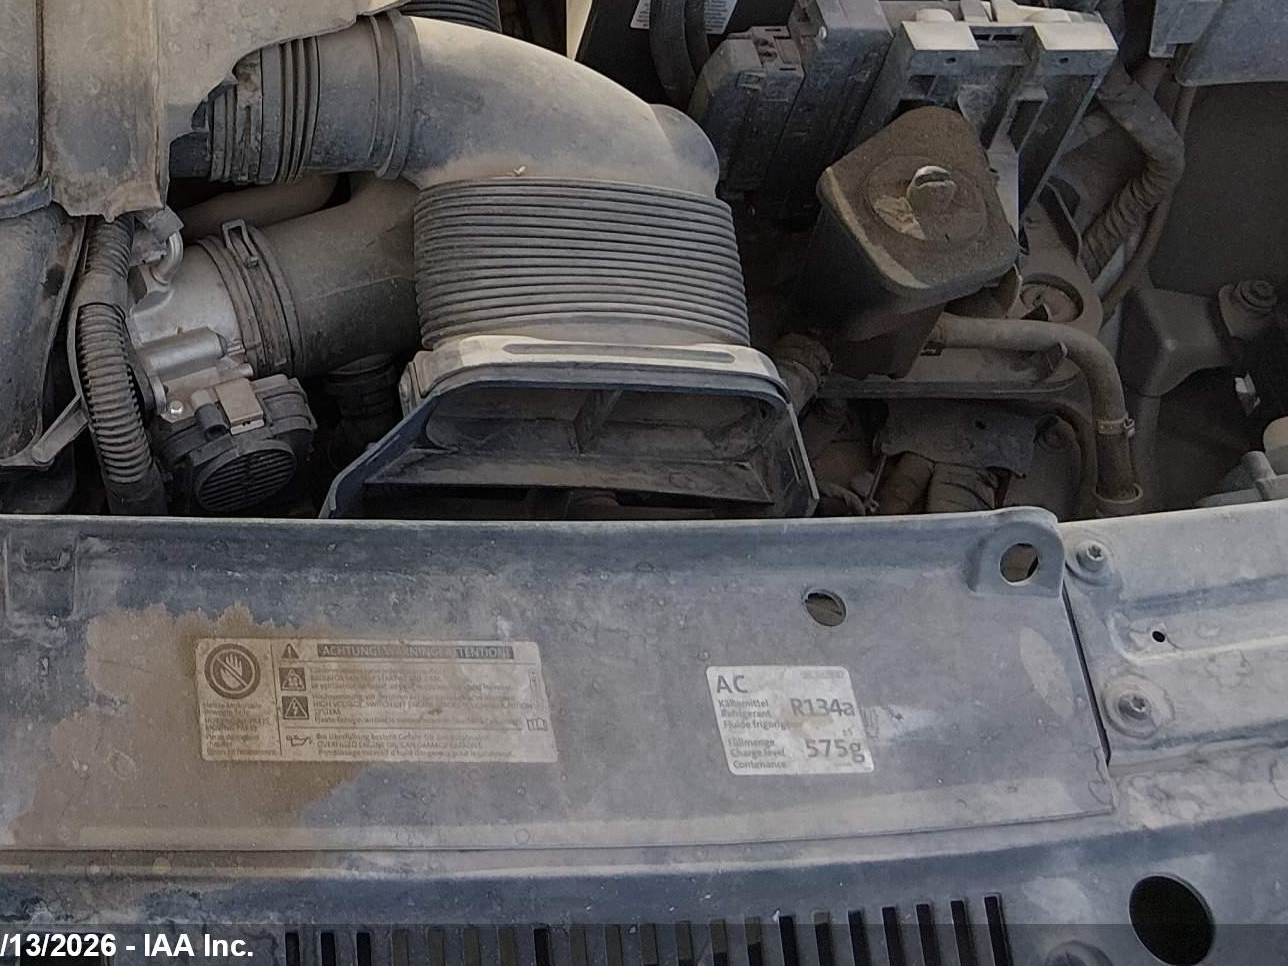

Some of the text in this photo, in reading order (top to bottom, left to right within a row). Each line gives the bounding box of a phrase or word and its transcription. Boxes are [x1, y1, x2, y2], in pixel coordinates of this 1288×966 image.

[716, 675, 749, 694] AC
[718, 698, 769, 708] Kältemittel
[790, 698, 856, 717] R134a
[728, 737, 776, 748] Füllmenge
[729, 748, 785, 759] Charge level
[805, 739, 866, 763] 575g
[732, 760, 787, 769] Contenance
